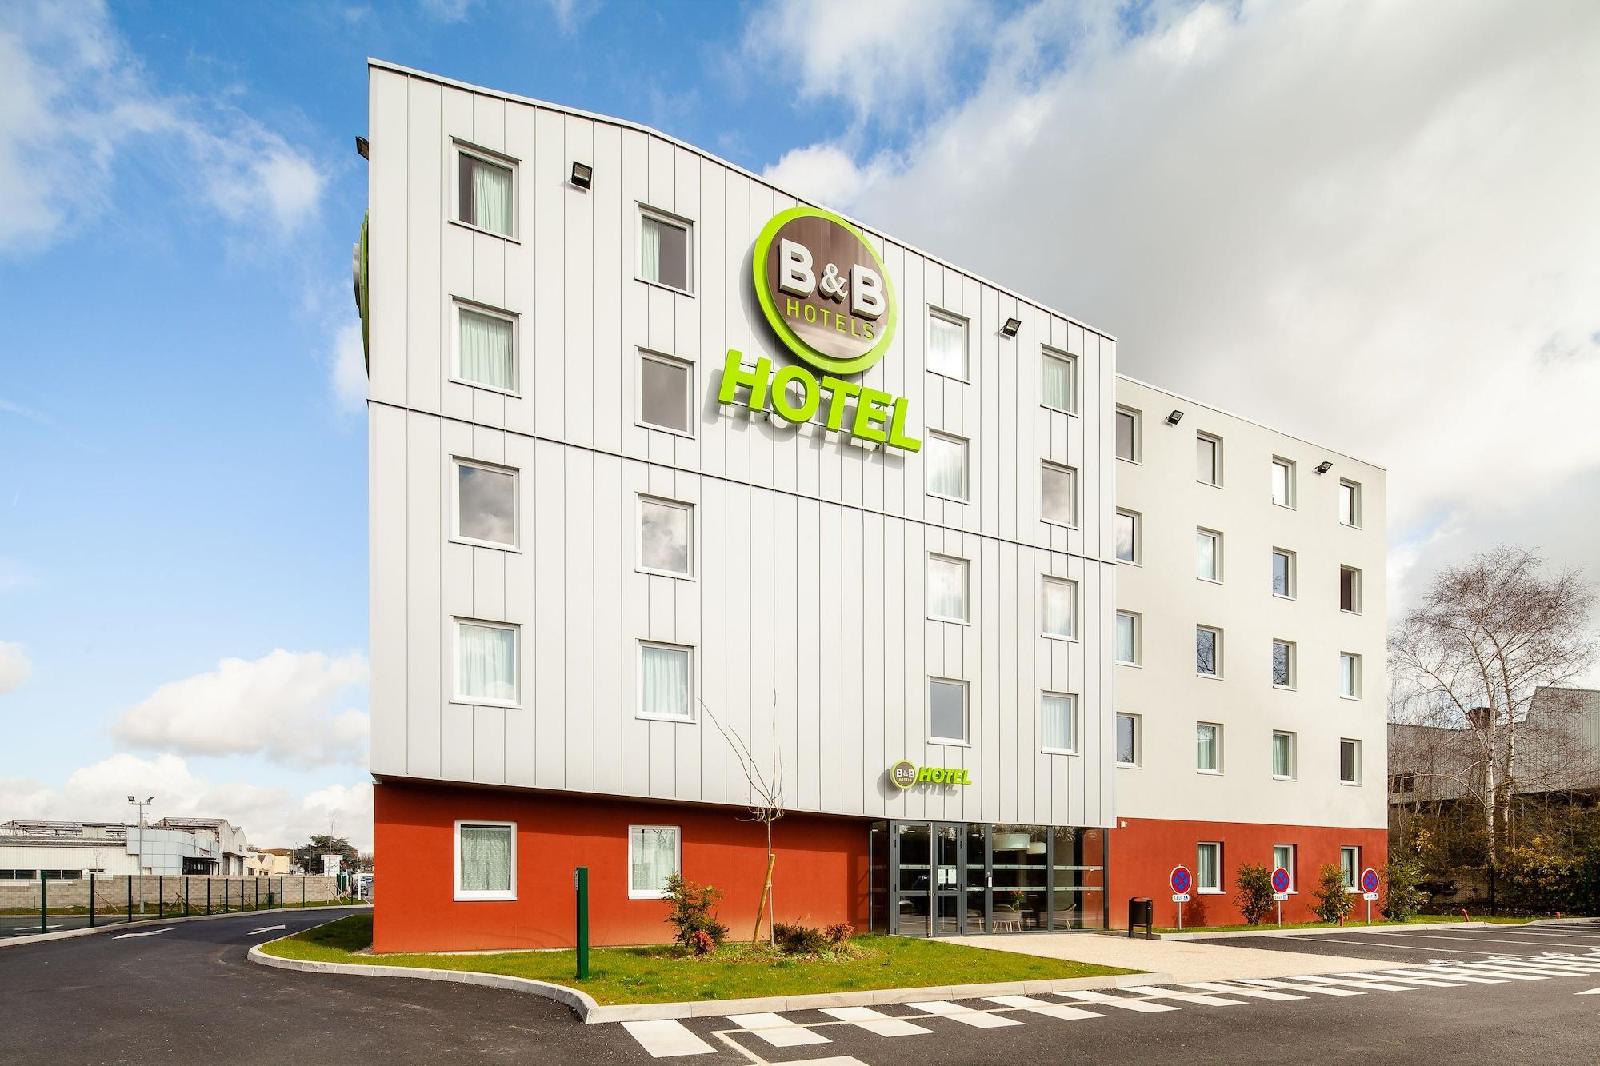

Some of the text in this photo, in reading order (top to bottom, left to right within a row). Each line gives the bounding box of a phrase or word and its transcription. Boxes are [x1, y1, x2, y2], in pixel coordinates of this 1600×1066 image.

[779, 238, 887, 320] B&B
[786, 297, 876, 341] HOTELS
[718, 348, 922, 453] HOTEL
[896, 767, 972, 785] B&B HOTEL
